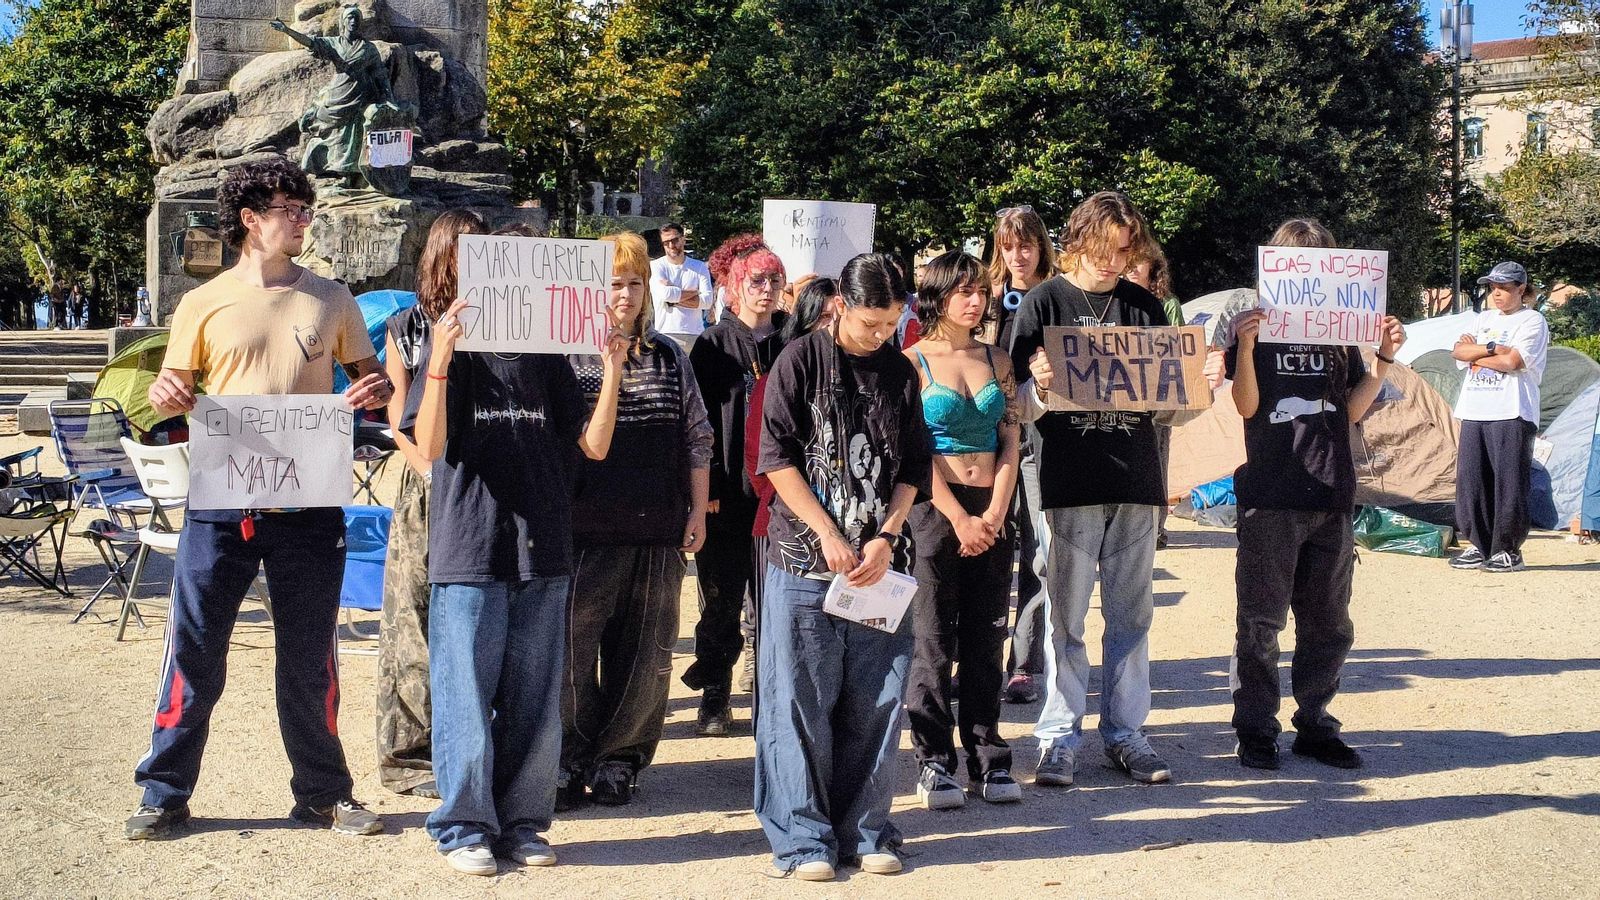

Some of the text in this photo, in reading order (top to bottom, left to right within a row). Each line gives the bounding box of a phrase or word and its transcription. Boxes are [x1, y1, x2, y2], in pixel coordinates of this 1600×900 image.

[336, 240, 380, 254] JUNIO
[791, 233, 830, 250] MATA
[467, 241, 607, 288] MARI CARMEN
[1262, 250, 1385, 282] COAS NOSAS
[1263, 277, 1377, 312] VIDAS NON
[464, 283, 609, 353] SOMOS TODAS
[1267, 308, 1382, 343] SE ESPECULA
[1062, 331, 1196, 359] O RENTISMO
[1066, 358, 1189, 405] MATA
[206, 405, 353, 437] O RENTISMO
[227, 454, 301, 497] MATA
